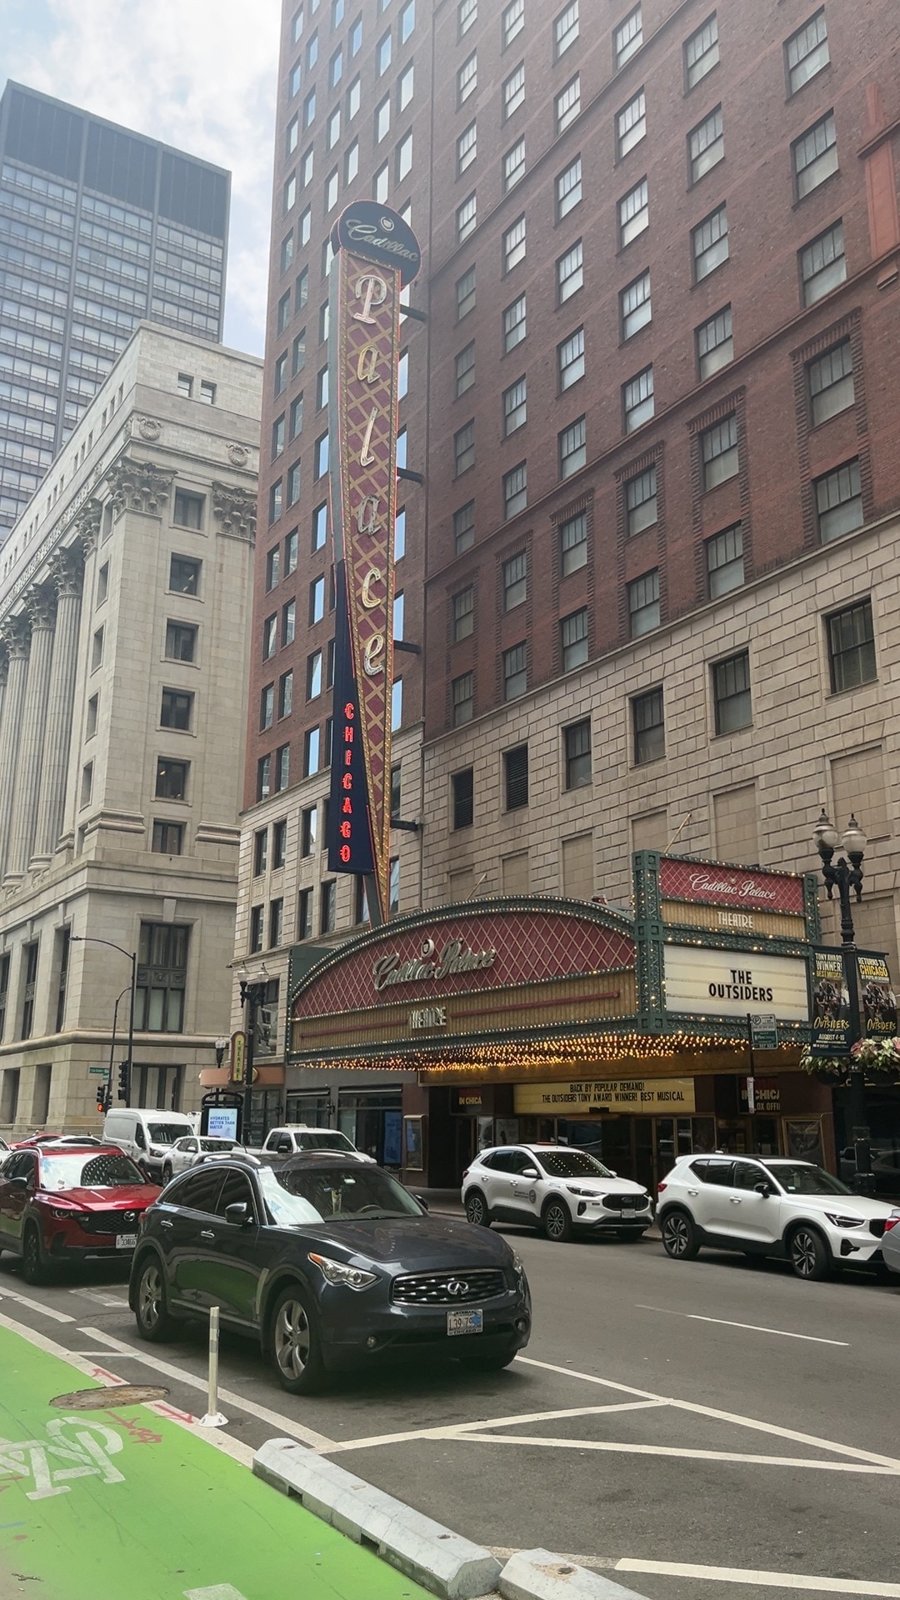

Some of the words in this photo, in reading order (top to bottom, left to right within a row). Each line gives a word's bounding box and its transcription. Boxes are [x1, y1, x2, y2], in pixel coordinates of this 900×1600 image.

[345, 219, 419, 263] Cadillac
[352, 274, 388, 677] Palace
[339, 702, 355, 861] CHICAGO
[688, 873, 737, 895] Cadillac
[738, 880, 776, 900] Palace
[717, 911, 753, 928] THEATRE
[372, 952, 435, 992] Cadillac
[434, 938, 497, 980] Palace
[860, 965, 888, 977] CHICAGO
[730, 969, 752, 984] THE
[708, 983, 773, 1001] OUTSIDERS
[818, 1033, 835, 1041] AUGUST
[569, 1083, 583, 1093] BACK
[585, 1083, 592, 1092] BY
[594, 1082, 617, 1092] POPULAR
[619, 1082, 645, 1091] DEMAND!
[542, 1094, 551, 1103] THE
[551, 1093, 577, 1103] OUTSIDERS
[578, 1093, 591, 1102] TONY
[593, 1093, 613, 1102] AWARD
[614, 1092, 638, 1101] WINNER!
[640, 1091, 655, 1101] BEST
[657, 1091, 685, 1101] MUSICAL
